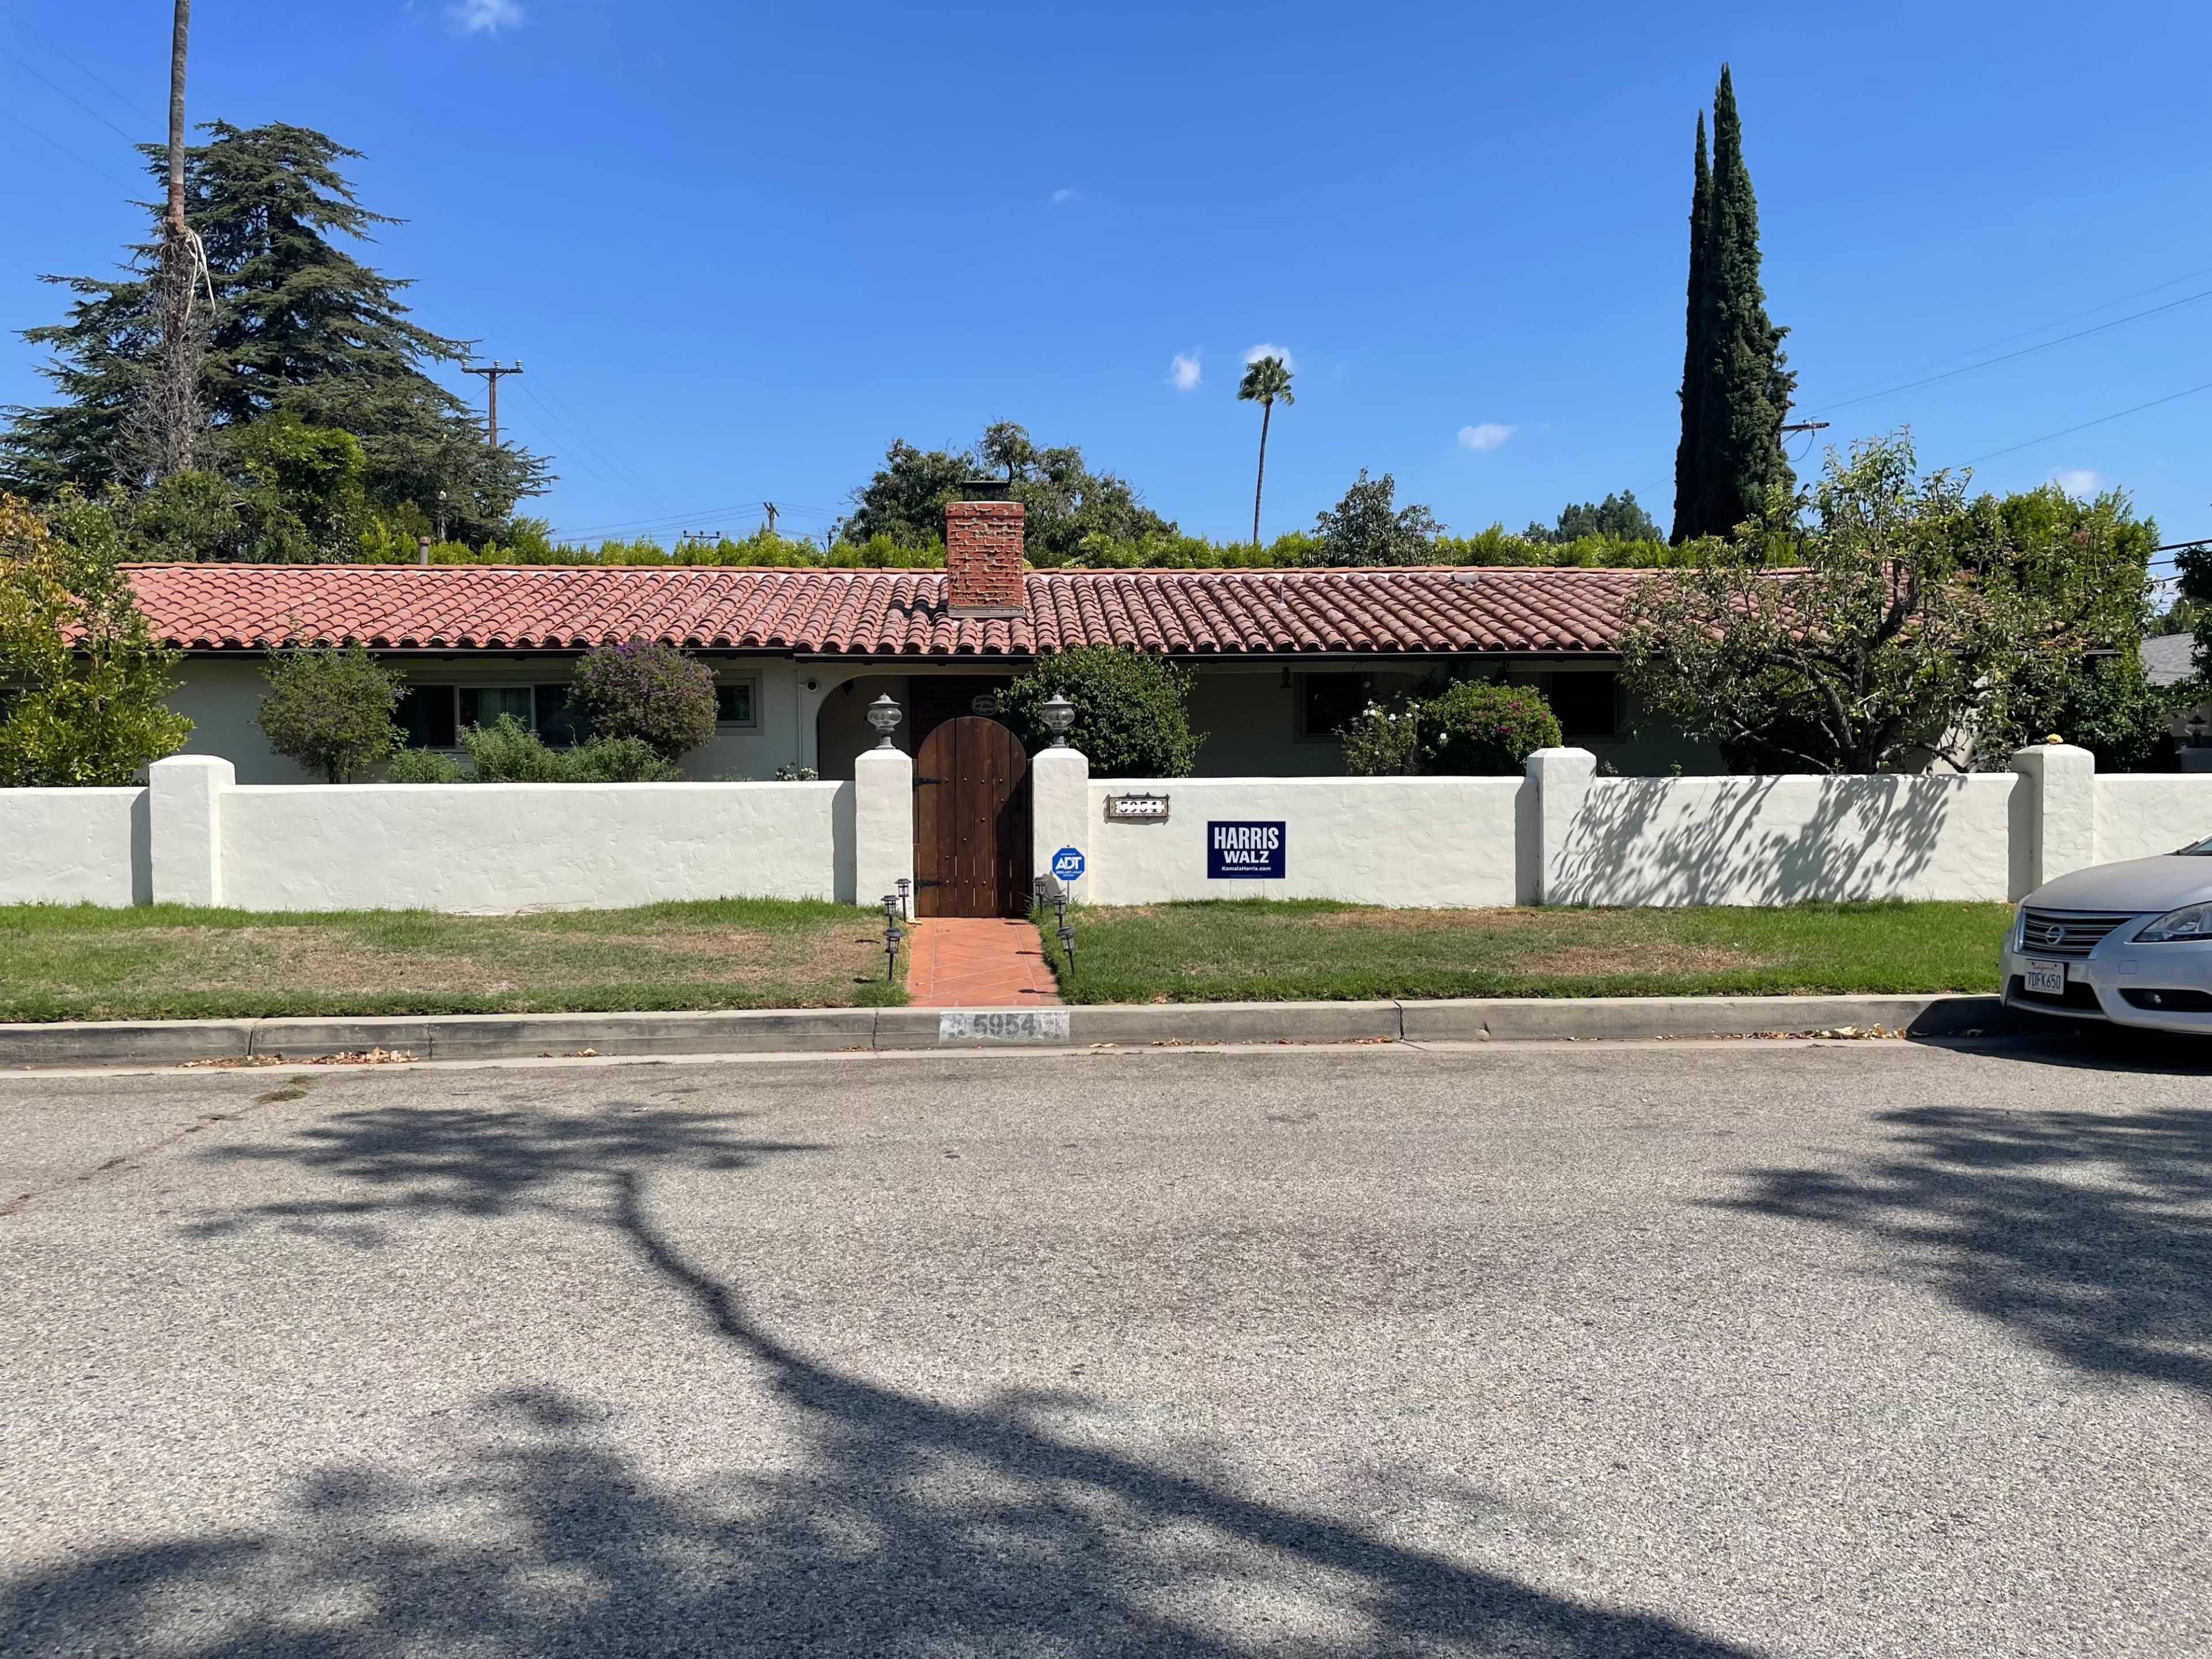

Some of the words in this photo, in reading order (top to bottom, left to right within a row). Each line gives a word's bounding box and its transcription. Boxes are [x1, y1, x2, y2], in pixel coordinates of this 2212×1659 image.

[1214, 827, 1279, 850] HARRIS
[1055, 857, 1082, 870] ADT
[1223, 850, 1270, 863] WALZ
[2027, 971, 2061, 989] 7DFK650
[974, 1013, 1036, 1036] 5954
